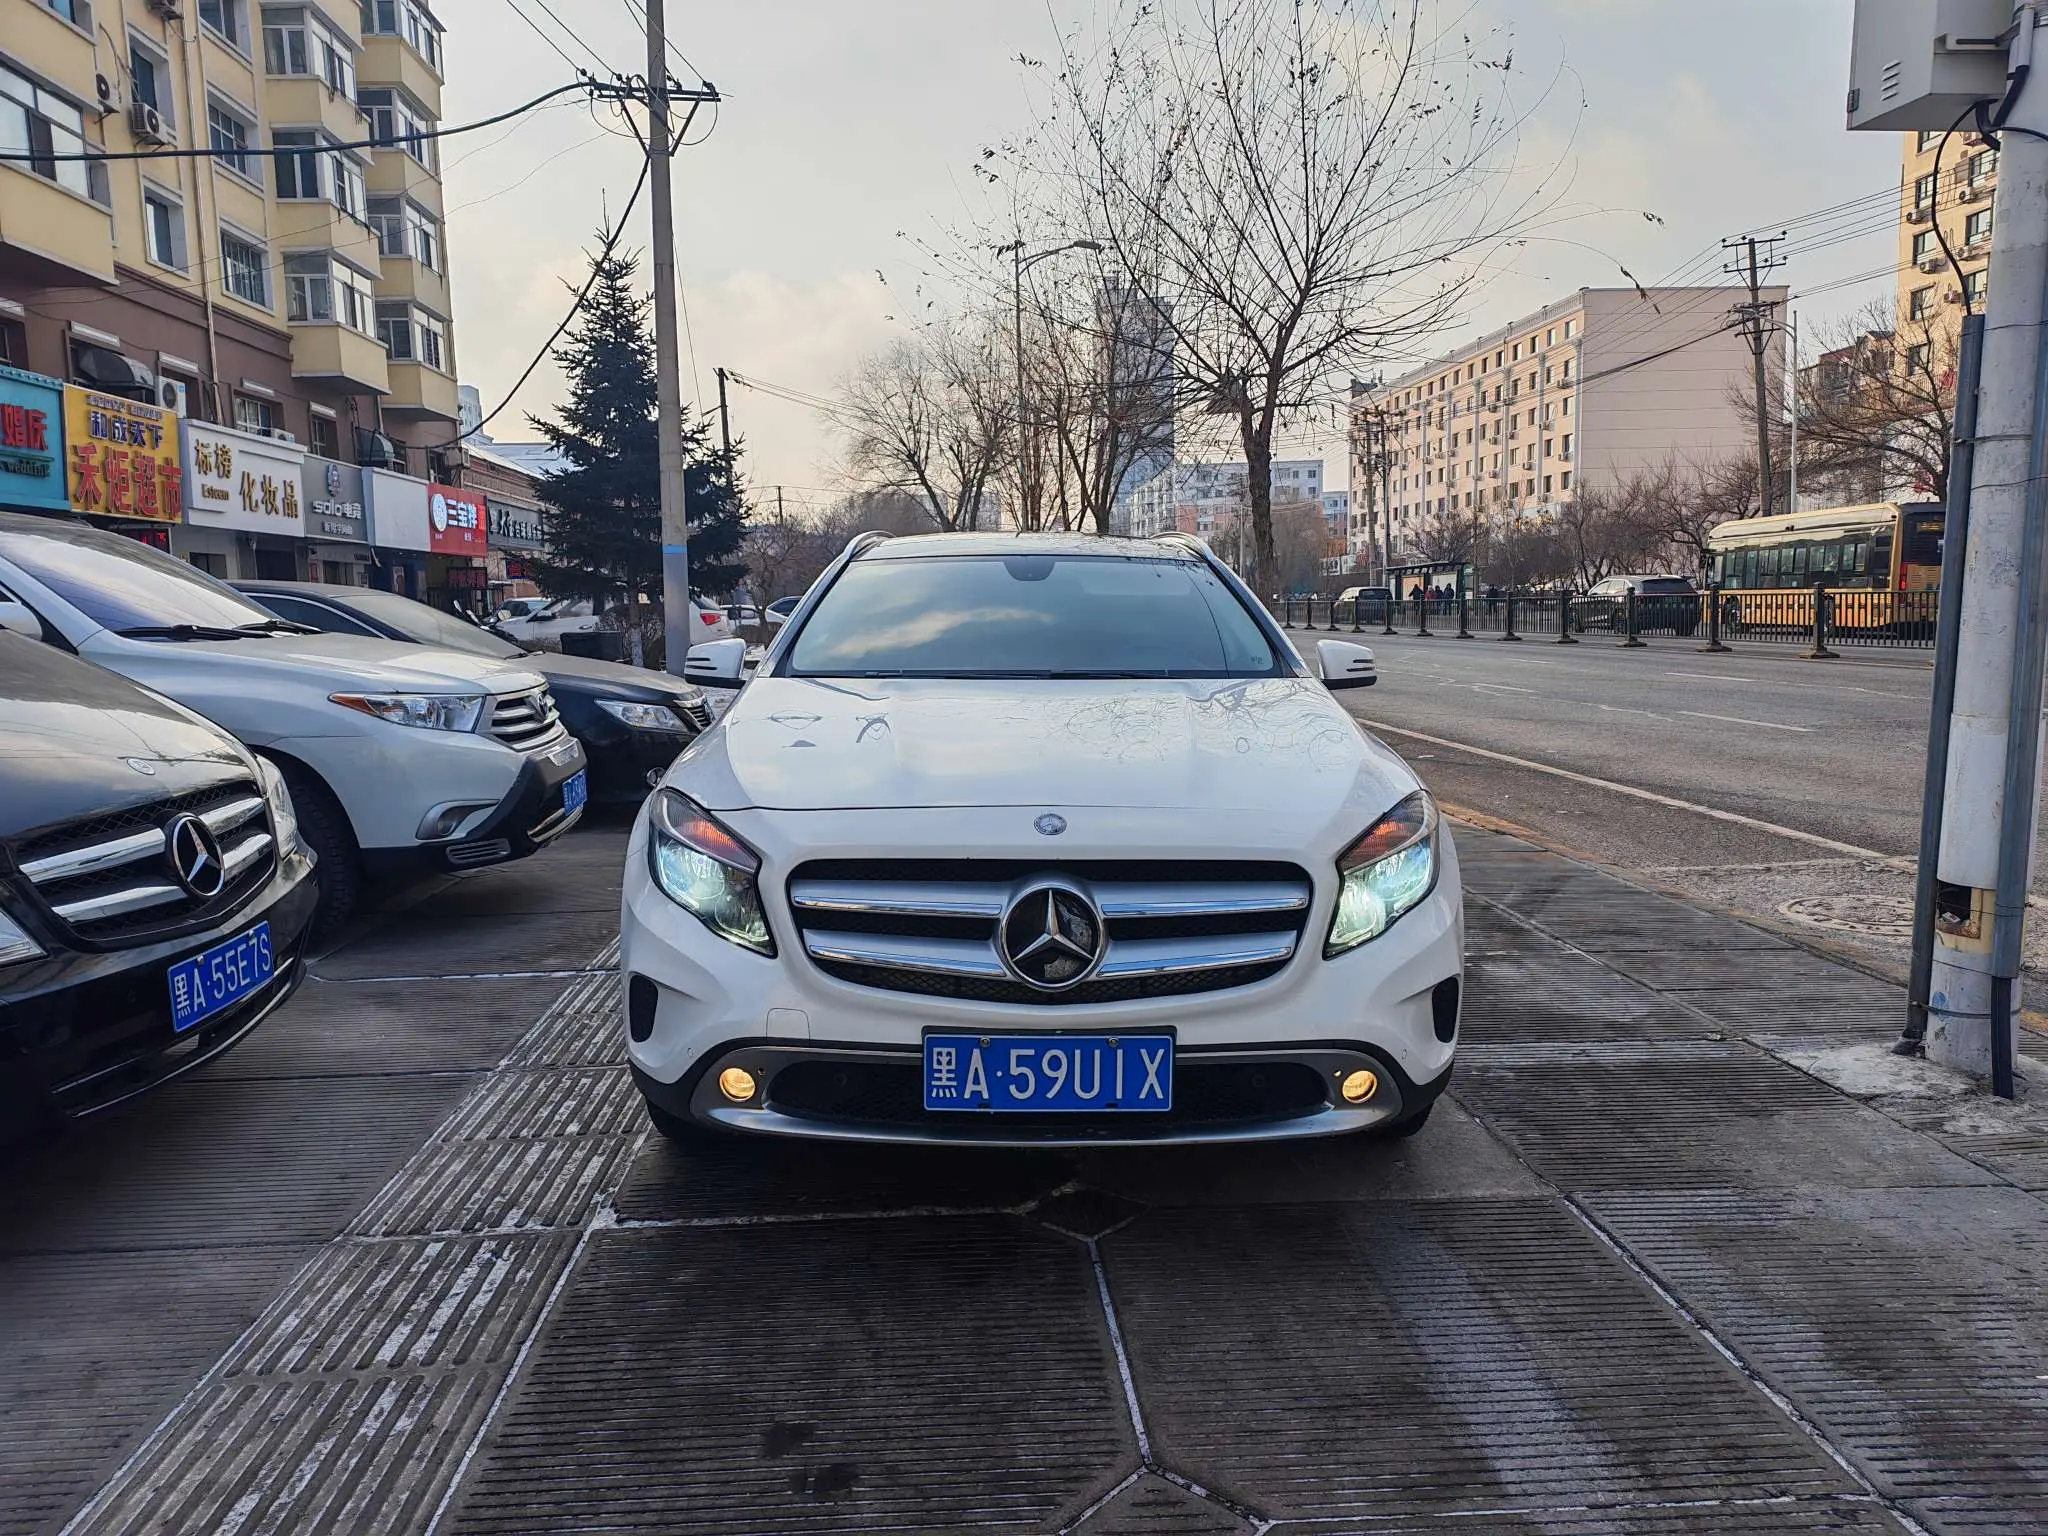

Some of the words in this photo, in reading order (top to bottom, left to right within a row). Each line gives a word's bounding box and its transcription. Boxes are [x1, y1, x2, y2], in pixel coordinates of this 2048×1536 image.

[90, 411, 164, 449] 和成天下
[74, 443, 182, 519] 禾炬超市
[195, 438, 232, 479] 标榜
[239, 471, 298, 518] 化妆品
[173, 932, 271, 1019] 黑A·55E7S
[931, 1047, 1164, 1100] 黑A·59U1X
